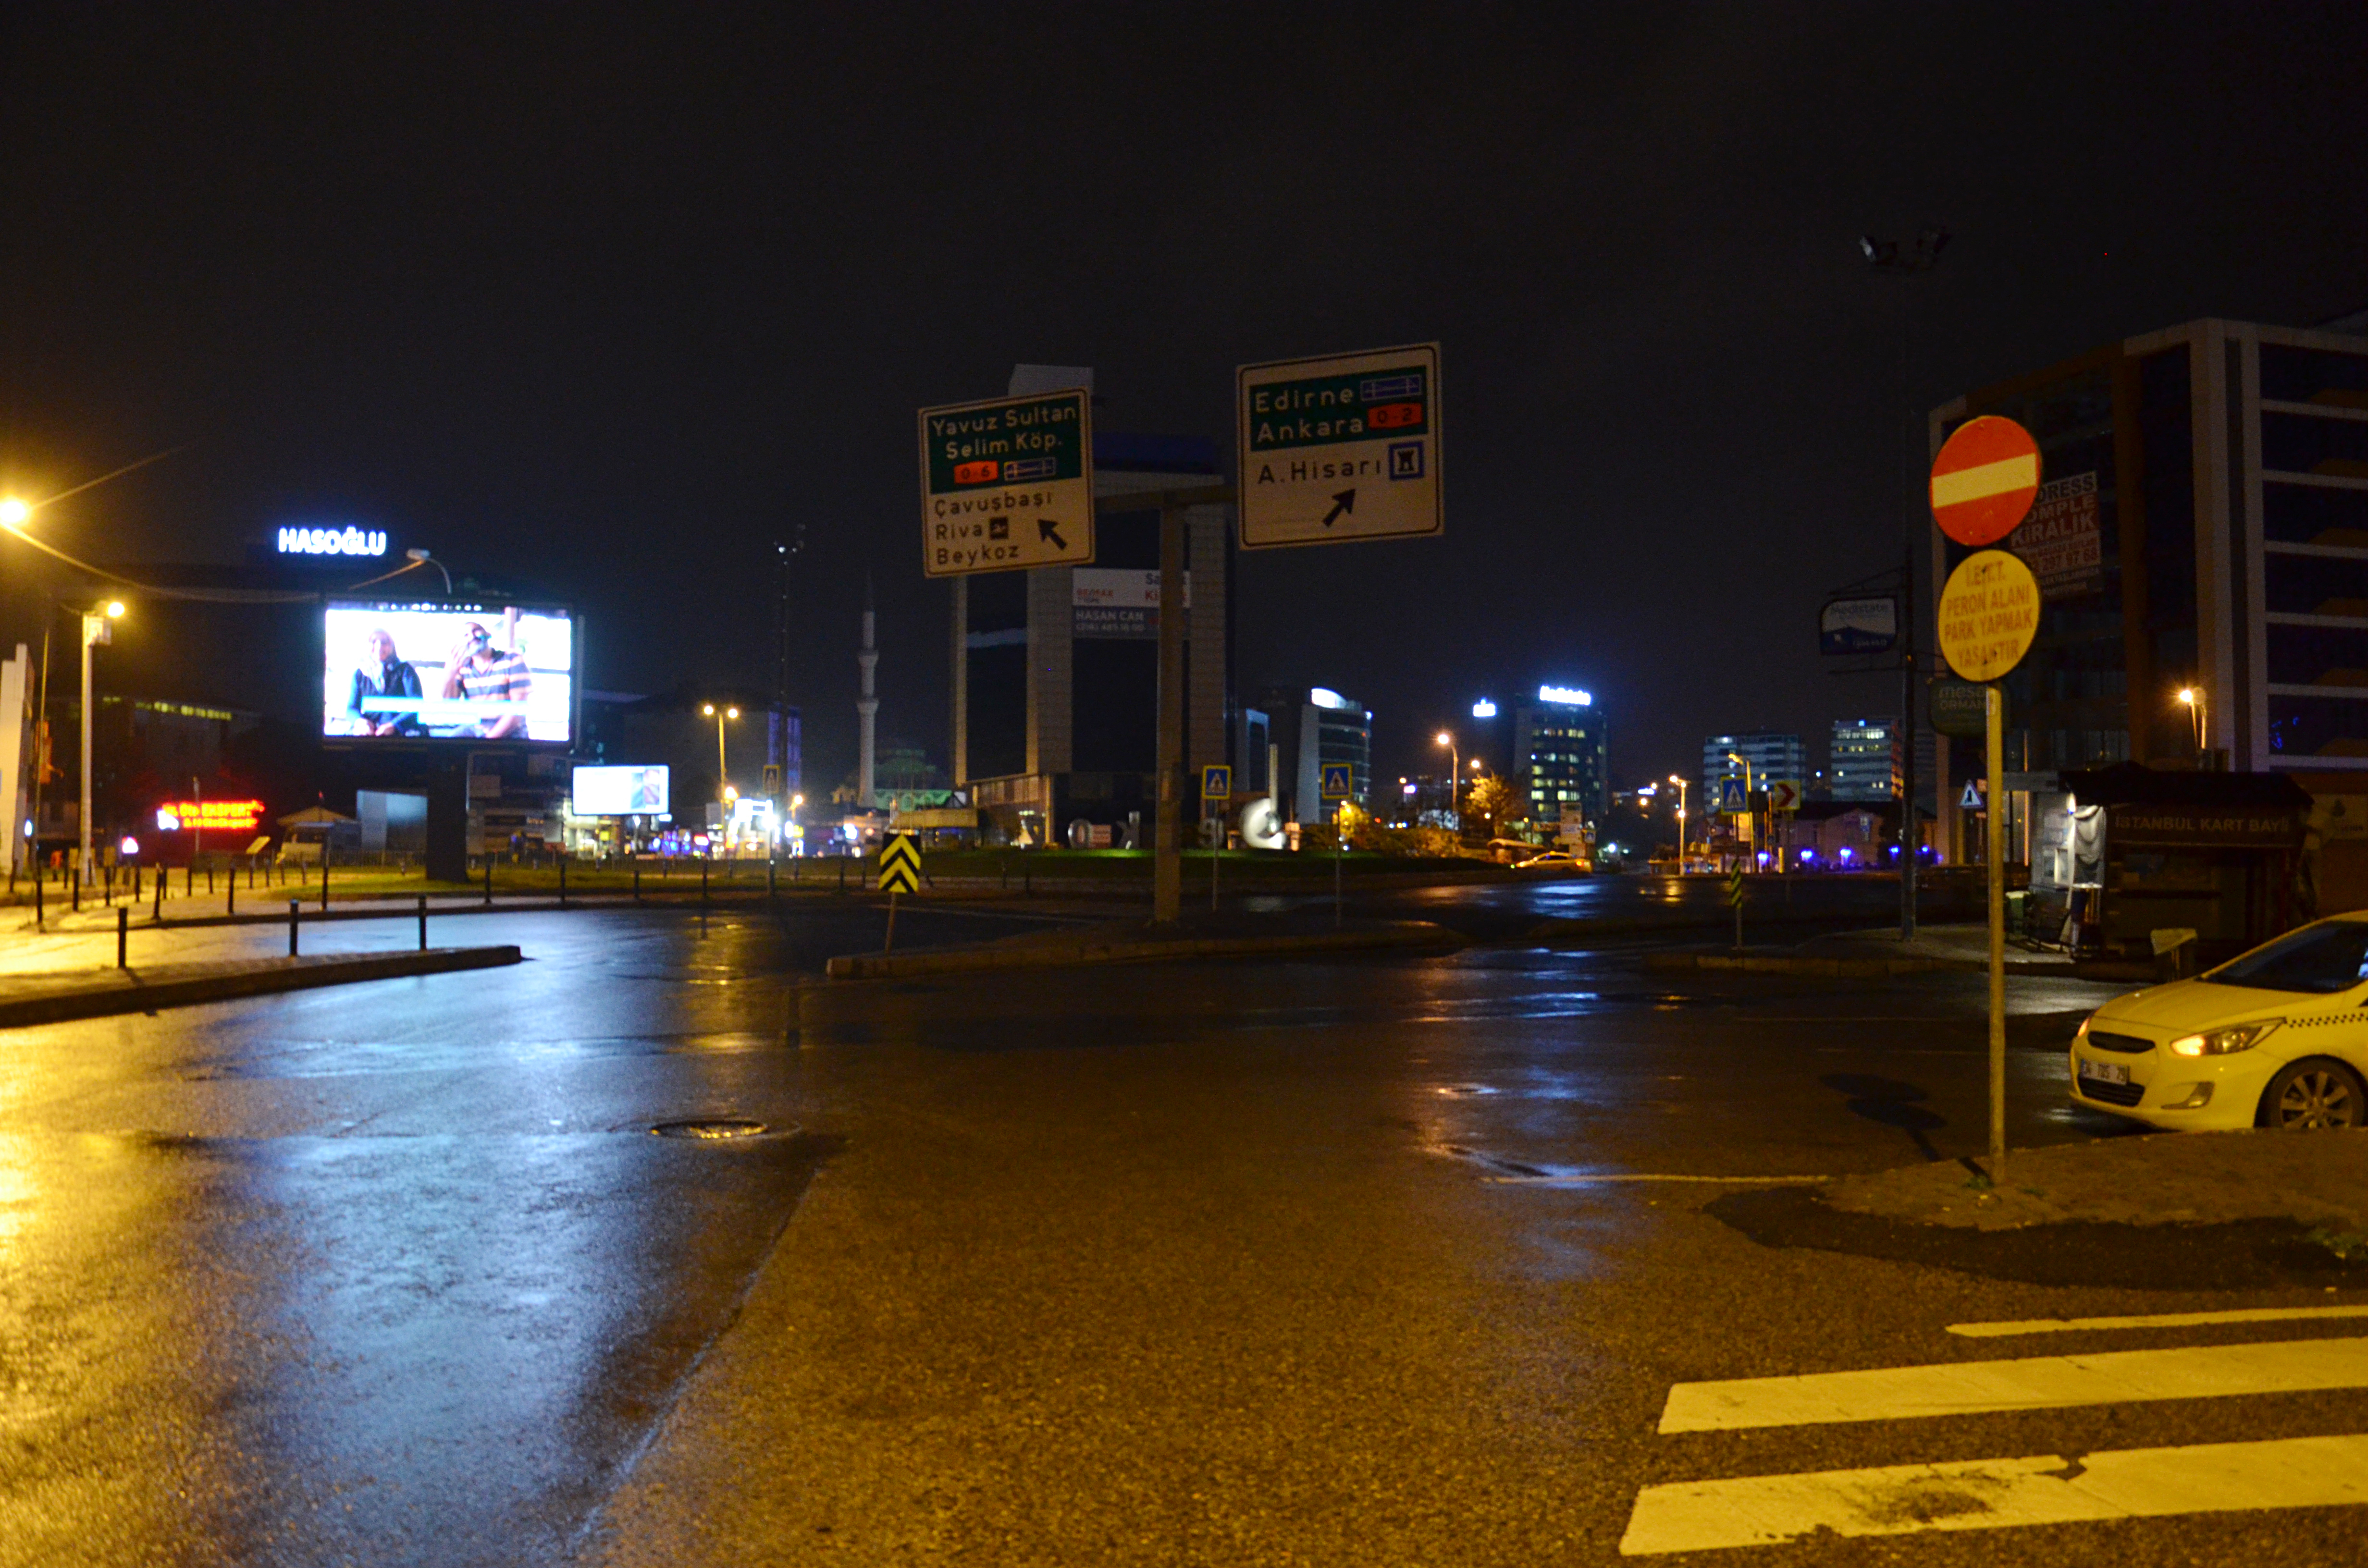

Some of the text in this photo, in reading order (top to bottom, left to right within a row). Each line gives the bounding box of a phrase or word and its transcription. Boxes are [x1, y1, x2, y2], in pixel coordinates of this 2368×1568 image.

[1254, 386, 1355, 414] Edirne
[932, 405, 1077, 437] Yavuz Sultan
[1256, 416, 1364, 446] Ankara
[945, 438, 1009, 460] Selim
[935, 491, 1052, 517] Çavuşbaşı
[278, 525, 387, 556] HASOĞLU
[936, 523, 983, 540] Riva
[936, 544, 1020, 567] Beykoz
[1947, 591, 1986, 618] PERON
[1991, 584, 2030, 610] ALANI
[1945, 607, 2033, 643] PARK YAPMAK
[1958, 638, 2020, 668] YASAKTIR
[2200, 818, 2244, 832] KART
